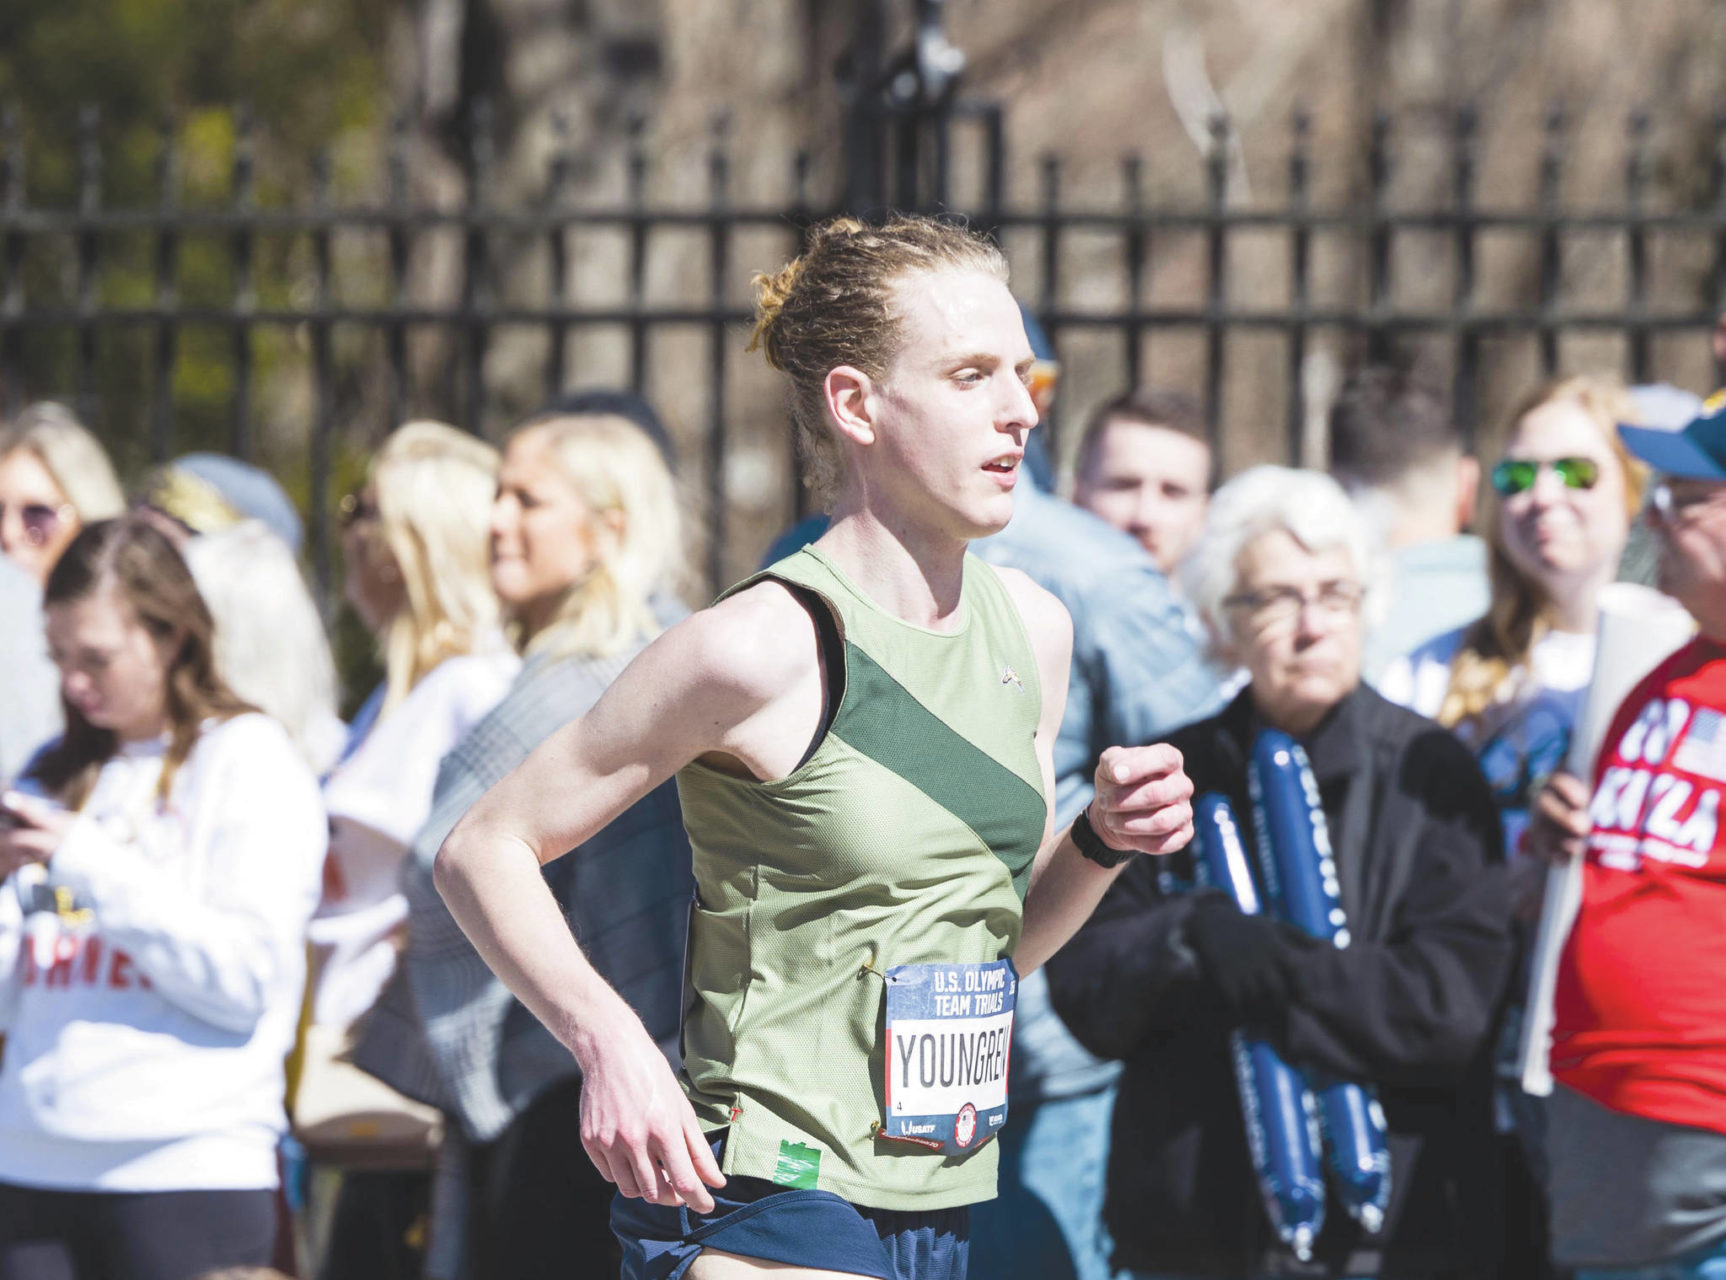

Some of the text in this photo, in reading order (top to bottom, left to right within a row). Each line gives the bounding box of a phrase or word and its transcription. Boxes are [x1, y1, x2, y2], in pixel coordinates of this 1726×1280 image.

[934, 971, 961, 992] U.S.
[965, 967, 1005, 992] OLYMPIC
[934, 991, 1003, 1016] TEAM TRIALS
[912, 1124, 936, 1134] USATF
